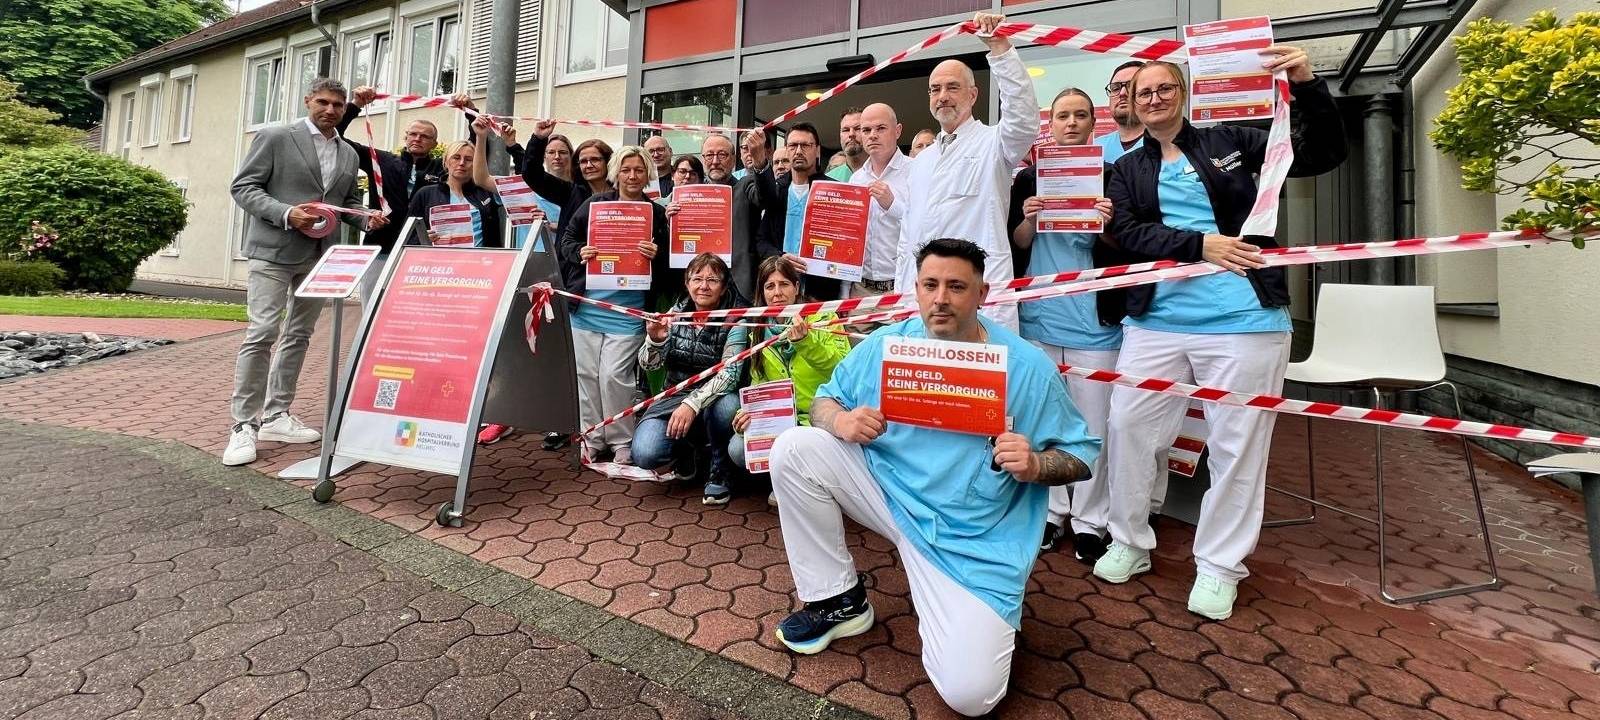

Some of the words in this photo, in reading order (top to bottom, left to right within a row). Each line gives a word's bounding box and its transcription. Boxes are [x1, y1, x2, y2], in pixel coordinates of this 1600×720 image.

[407, 265, 429, 274] KEIN
[430, 266, 455, 275] GELD.
[403, 275, 430, 285] KEINE
[431, 277, 493, 288] VERSORGUNG.
[889, 344, 1001, 364] GESCHLOSSEN!
[887, 367, 913, 378] KEIN
[914, 370, 946, 381] GELD.
[887, 379, 919, 390] KEINE
[920, 382, 999, 399] VERSORGUNG.
[418, 432, 452, 440] KATHOLISCHER
